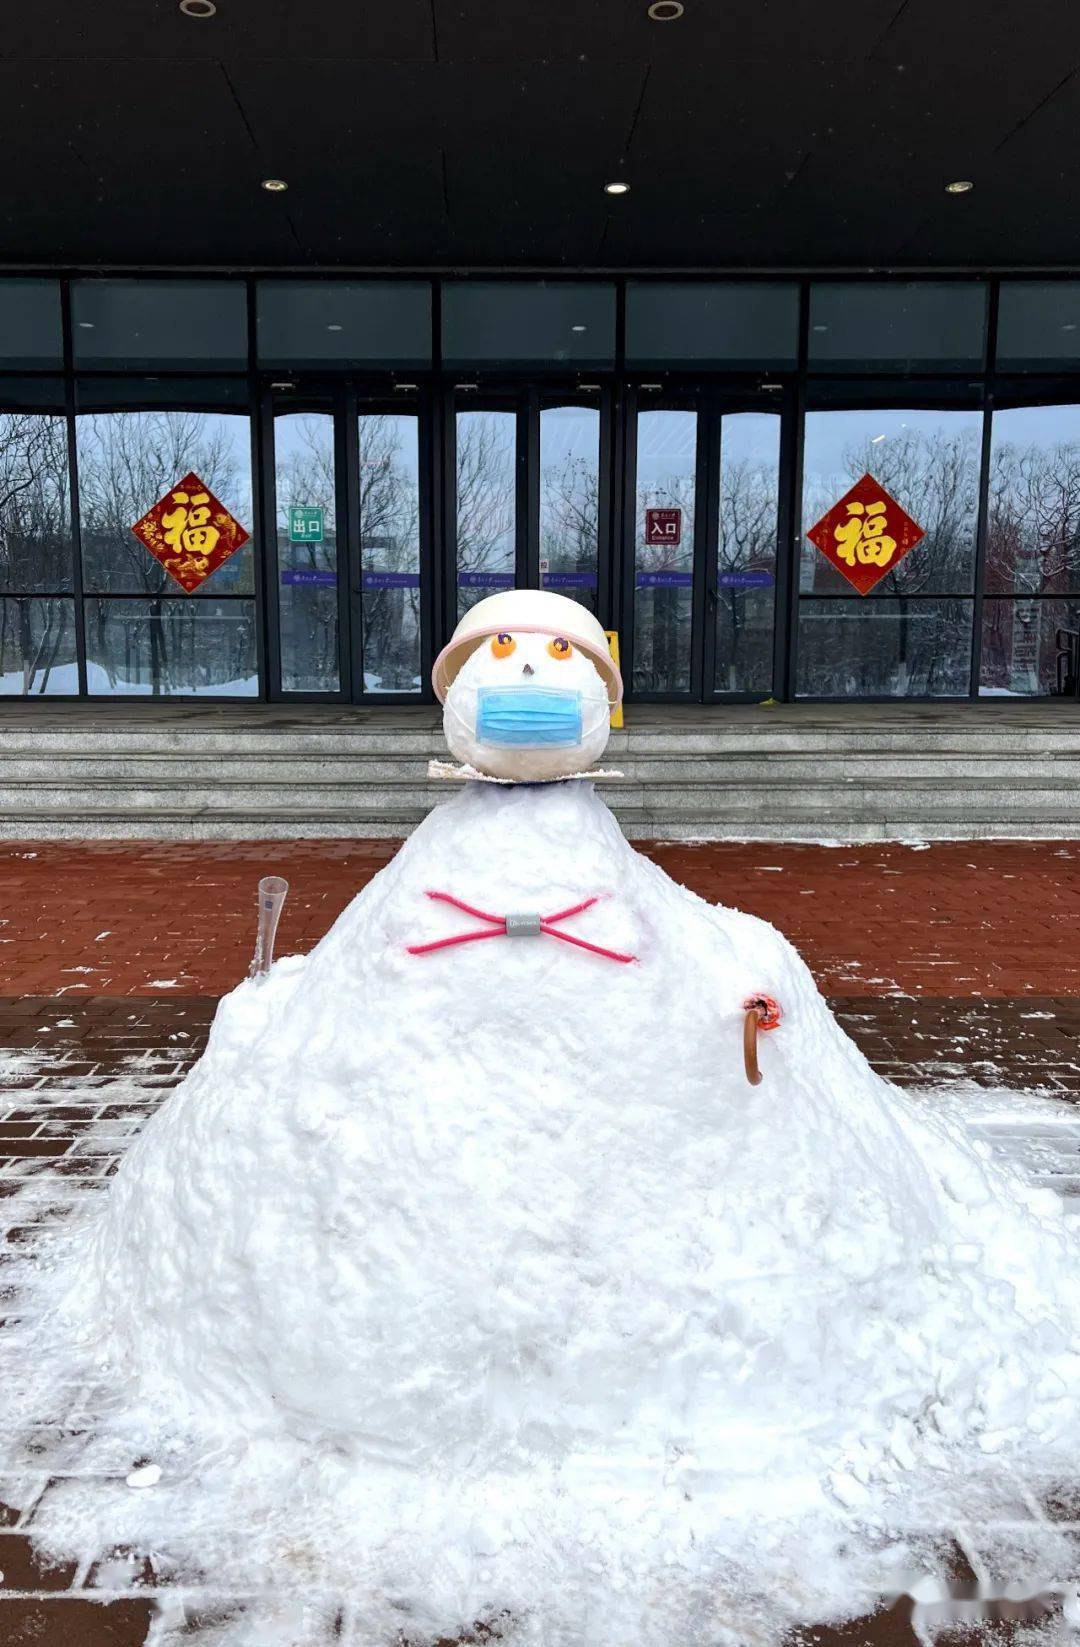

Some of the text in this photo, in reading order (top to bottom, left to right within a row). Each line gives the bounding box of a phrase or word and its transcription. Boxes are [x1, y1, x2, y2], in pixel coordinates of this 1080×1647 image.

[162, 492, 220, 555] 福
[293, 519, 320, 533] 出口
[651, 522, 676, 534] 入口
[834, 501, 897, 567] 福
